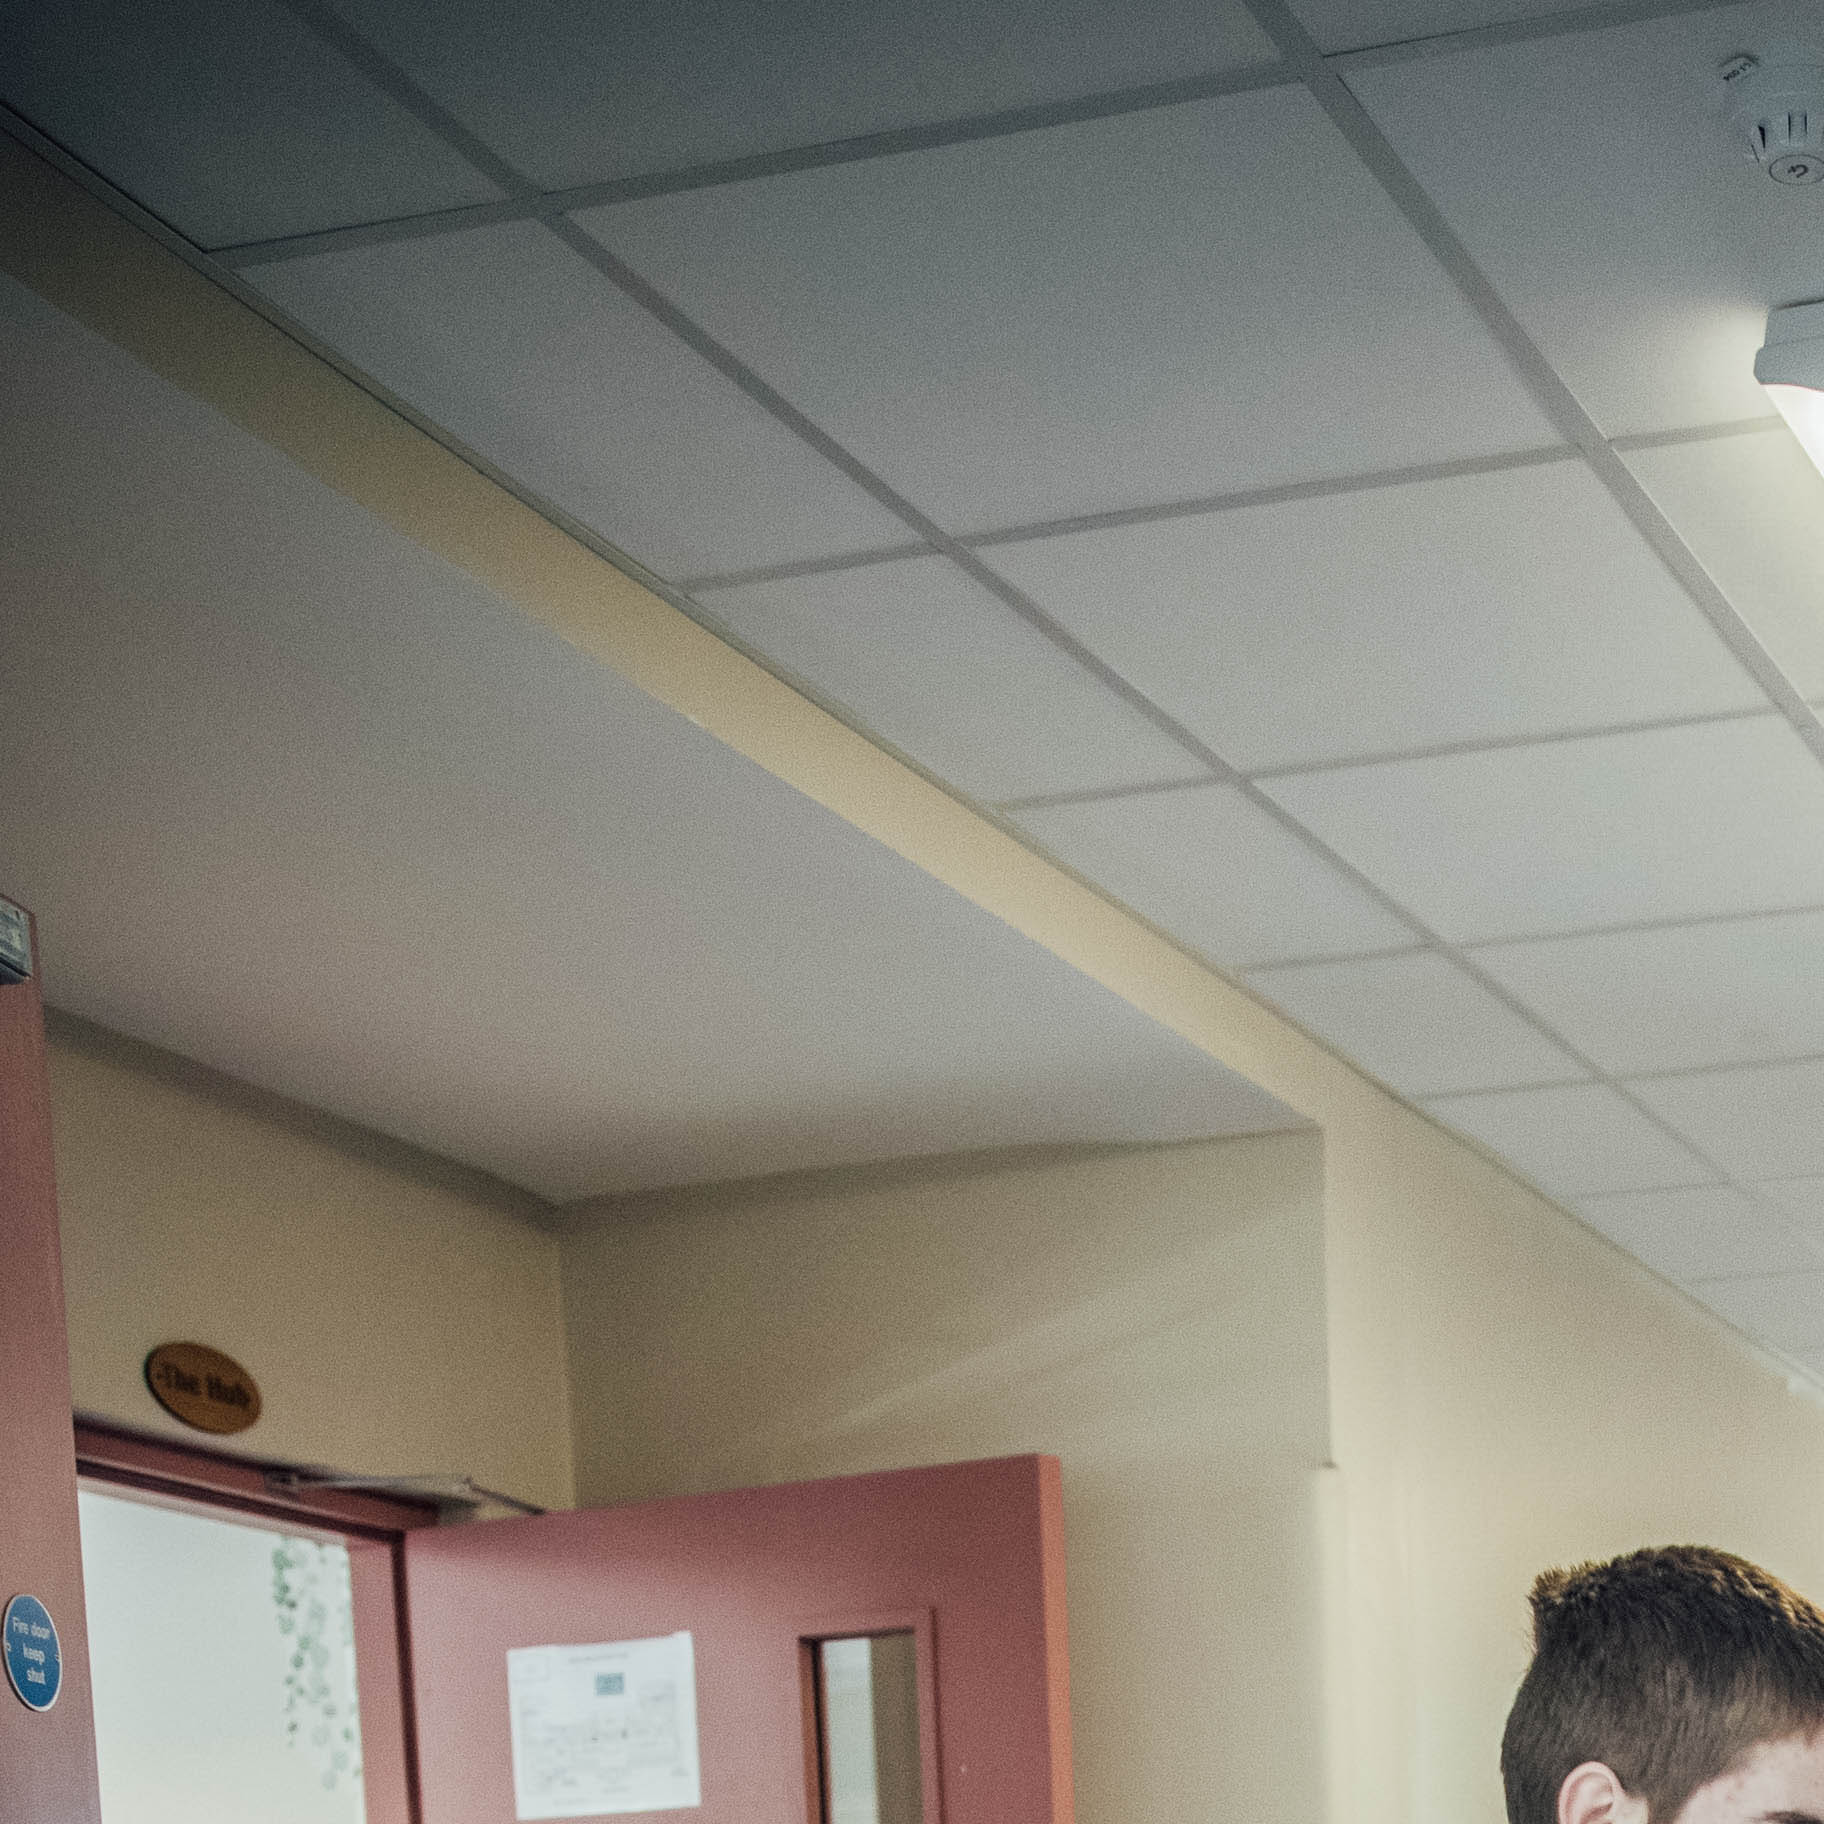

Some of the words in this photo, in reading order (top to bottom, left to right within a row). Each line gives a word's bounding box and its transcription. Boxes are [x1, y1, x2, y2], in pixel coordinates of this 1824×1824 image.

[12, 1616, 30, 1635] Fire
[31, 1622, 51, 1640] door
[23, 1642, 46, 1666] keep
[26, 1666, 46, 1685] shut
